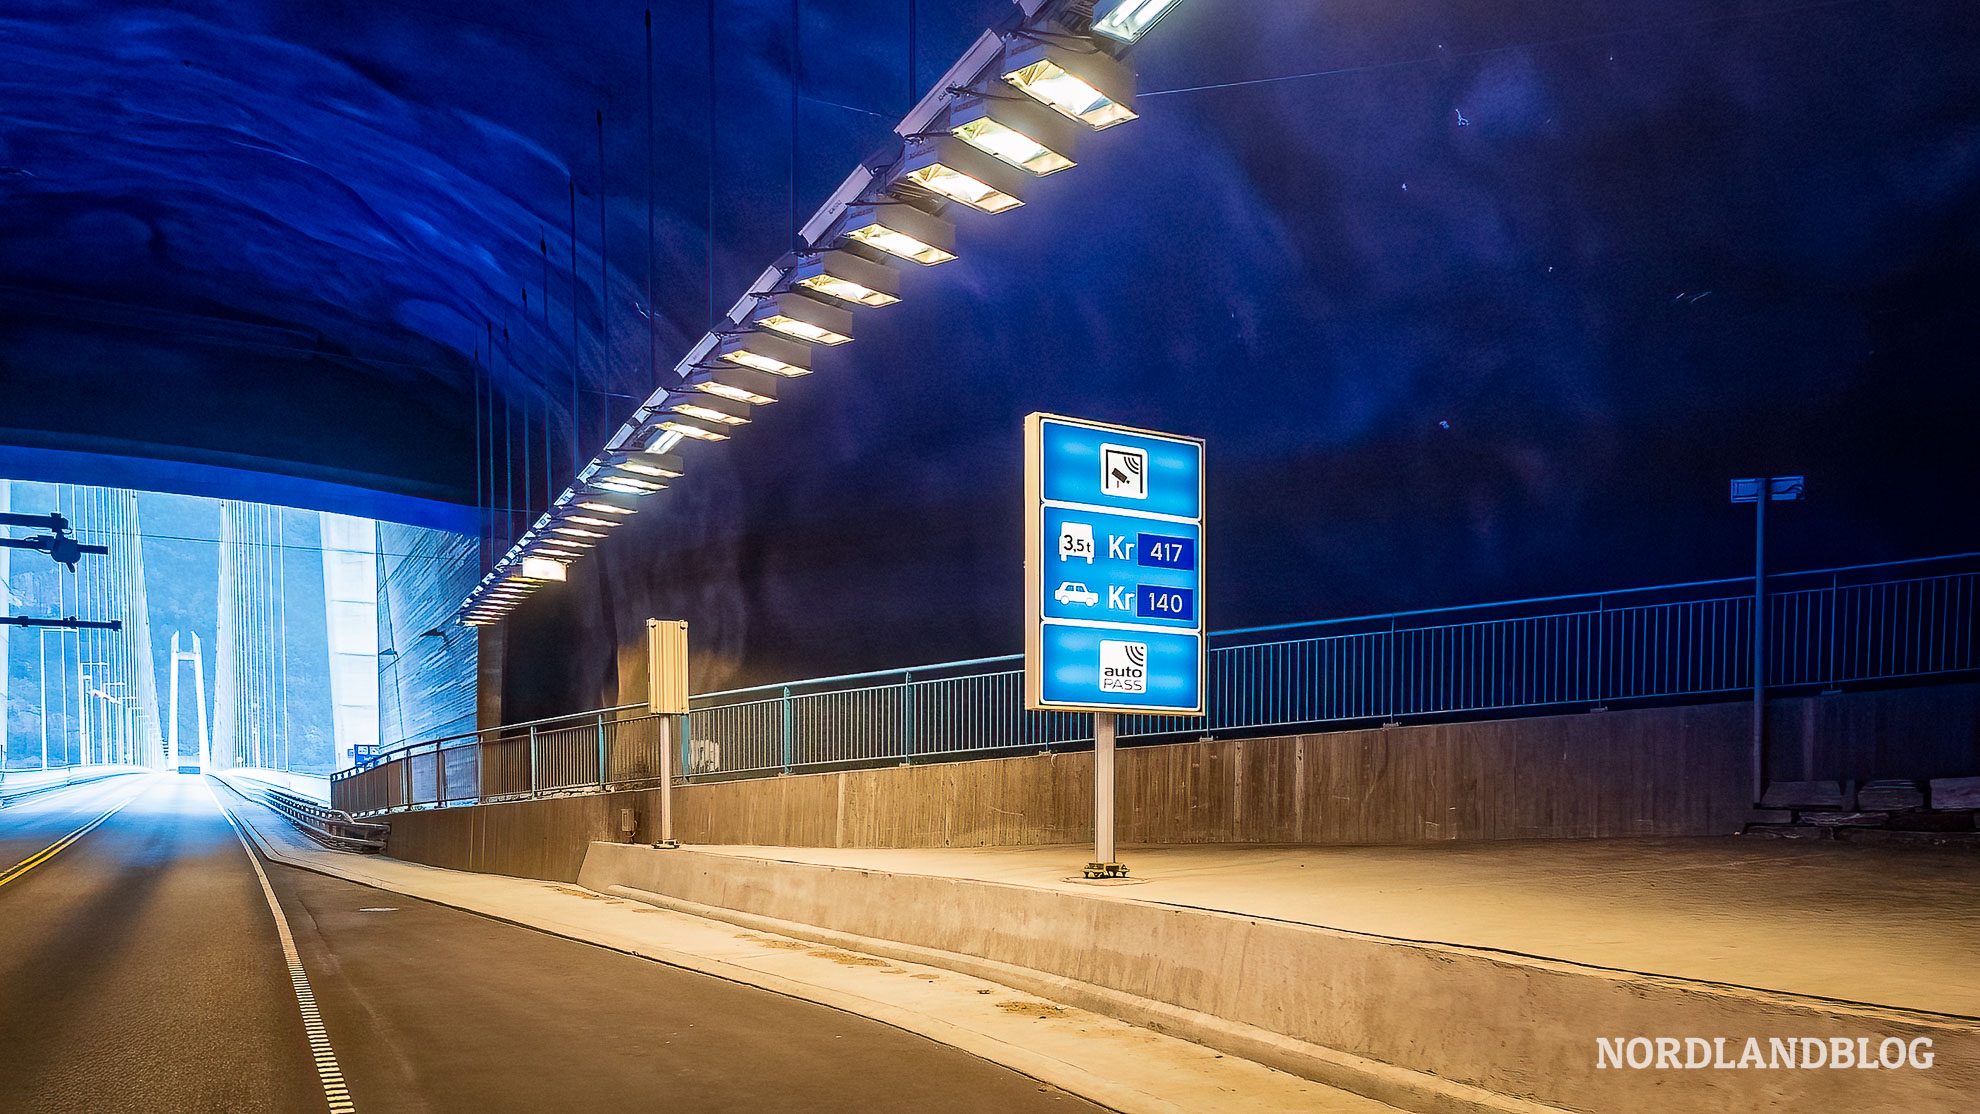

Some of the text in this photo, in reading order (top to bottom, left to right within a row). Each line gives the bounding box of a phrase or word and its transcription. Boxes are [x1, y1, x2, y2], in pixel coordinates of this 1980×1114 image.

[1108, 534, 1135, 560] Kr
[1150, 542, 1183, 562] 417
[1108, 585, 1183, 613] Kr 140
[1104, 666, 1142, 678] auto
[1103, 678, 1142, 691] PASS
